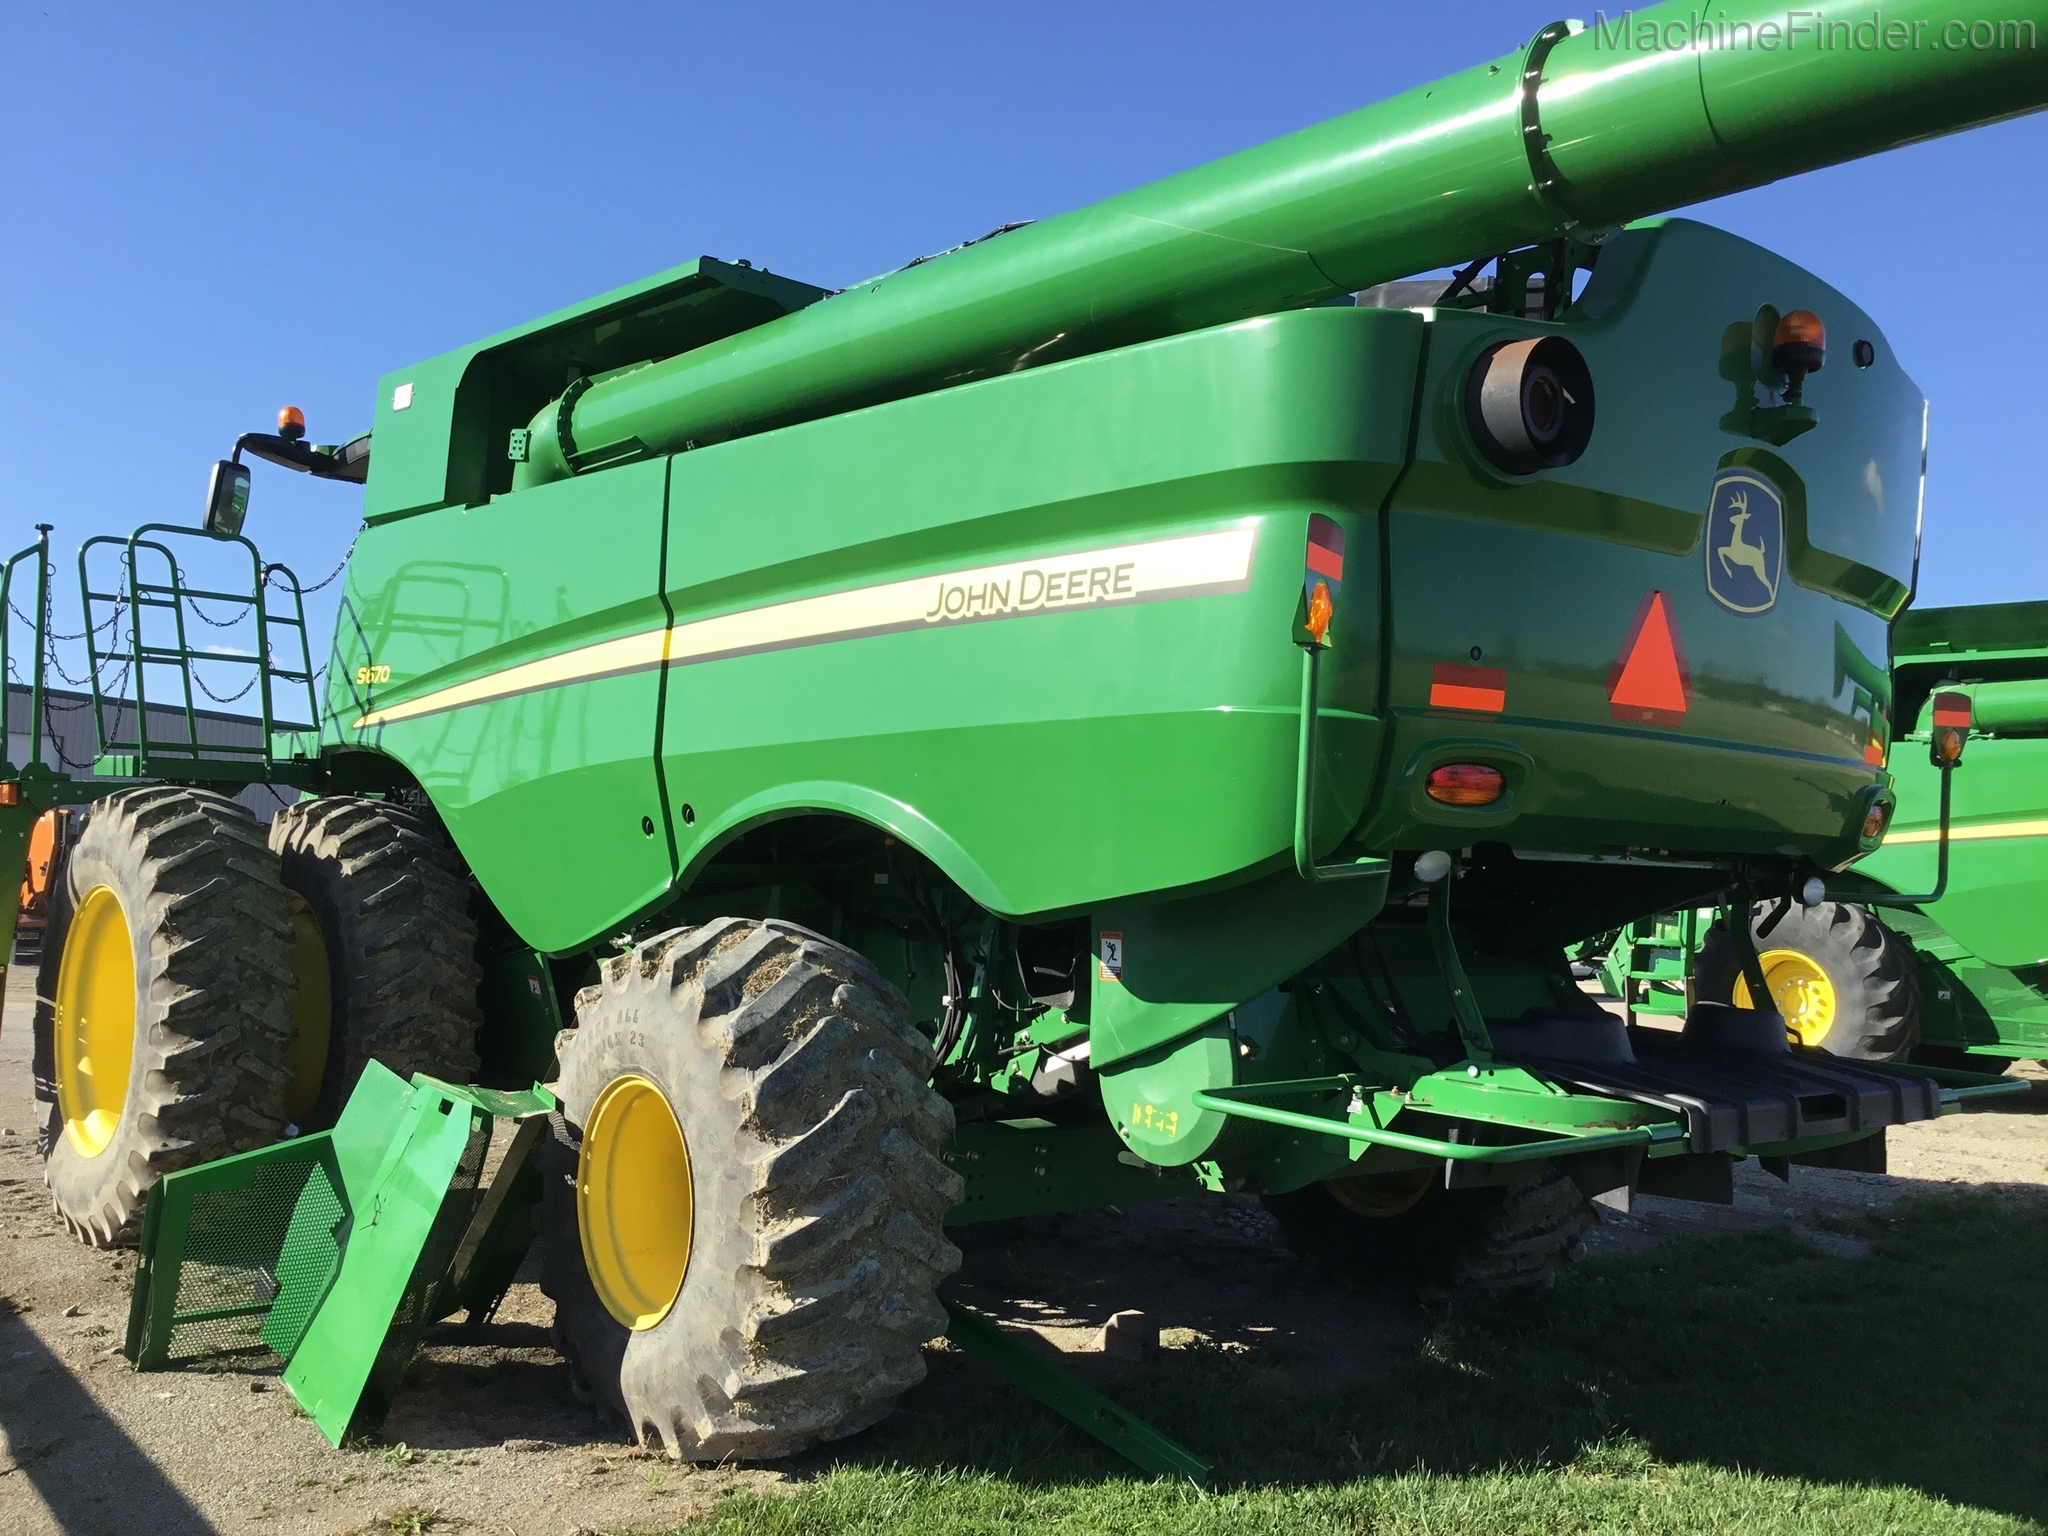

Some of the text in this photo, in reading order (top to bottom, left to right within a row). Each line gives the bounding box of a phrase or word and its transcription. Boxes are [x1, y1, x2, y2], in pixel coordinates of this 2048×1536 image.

[926, 562, 1136, 618] JOHN DEERE
[356, 664, 391, 686] S670
[616, 1008, 640, 1025] ALL
[629, 1030, 645, 1048] 23
